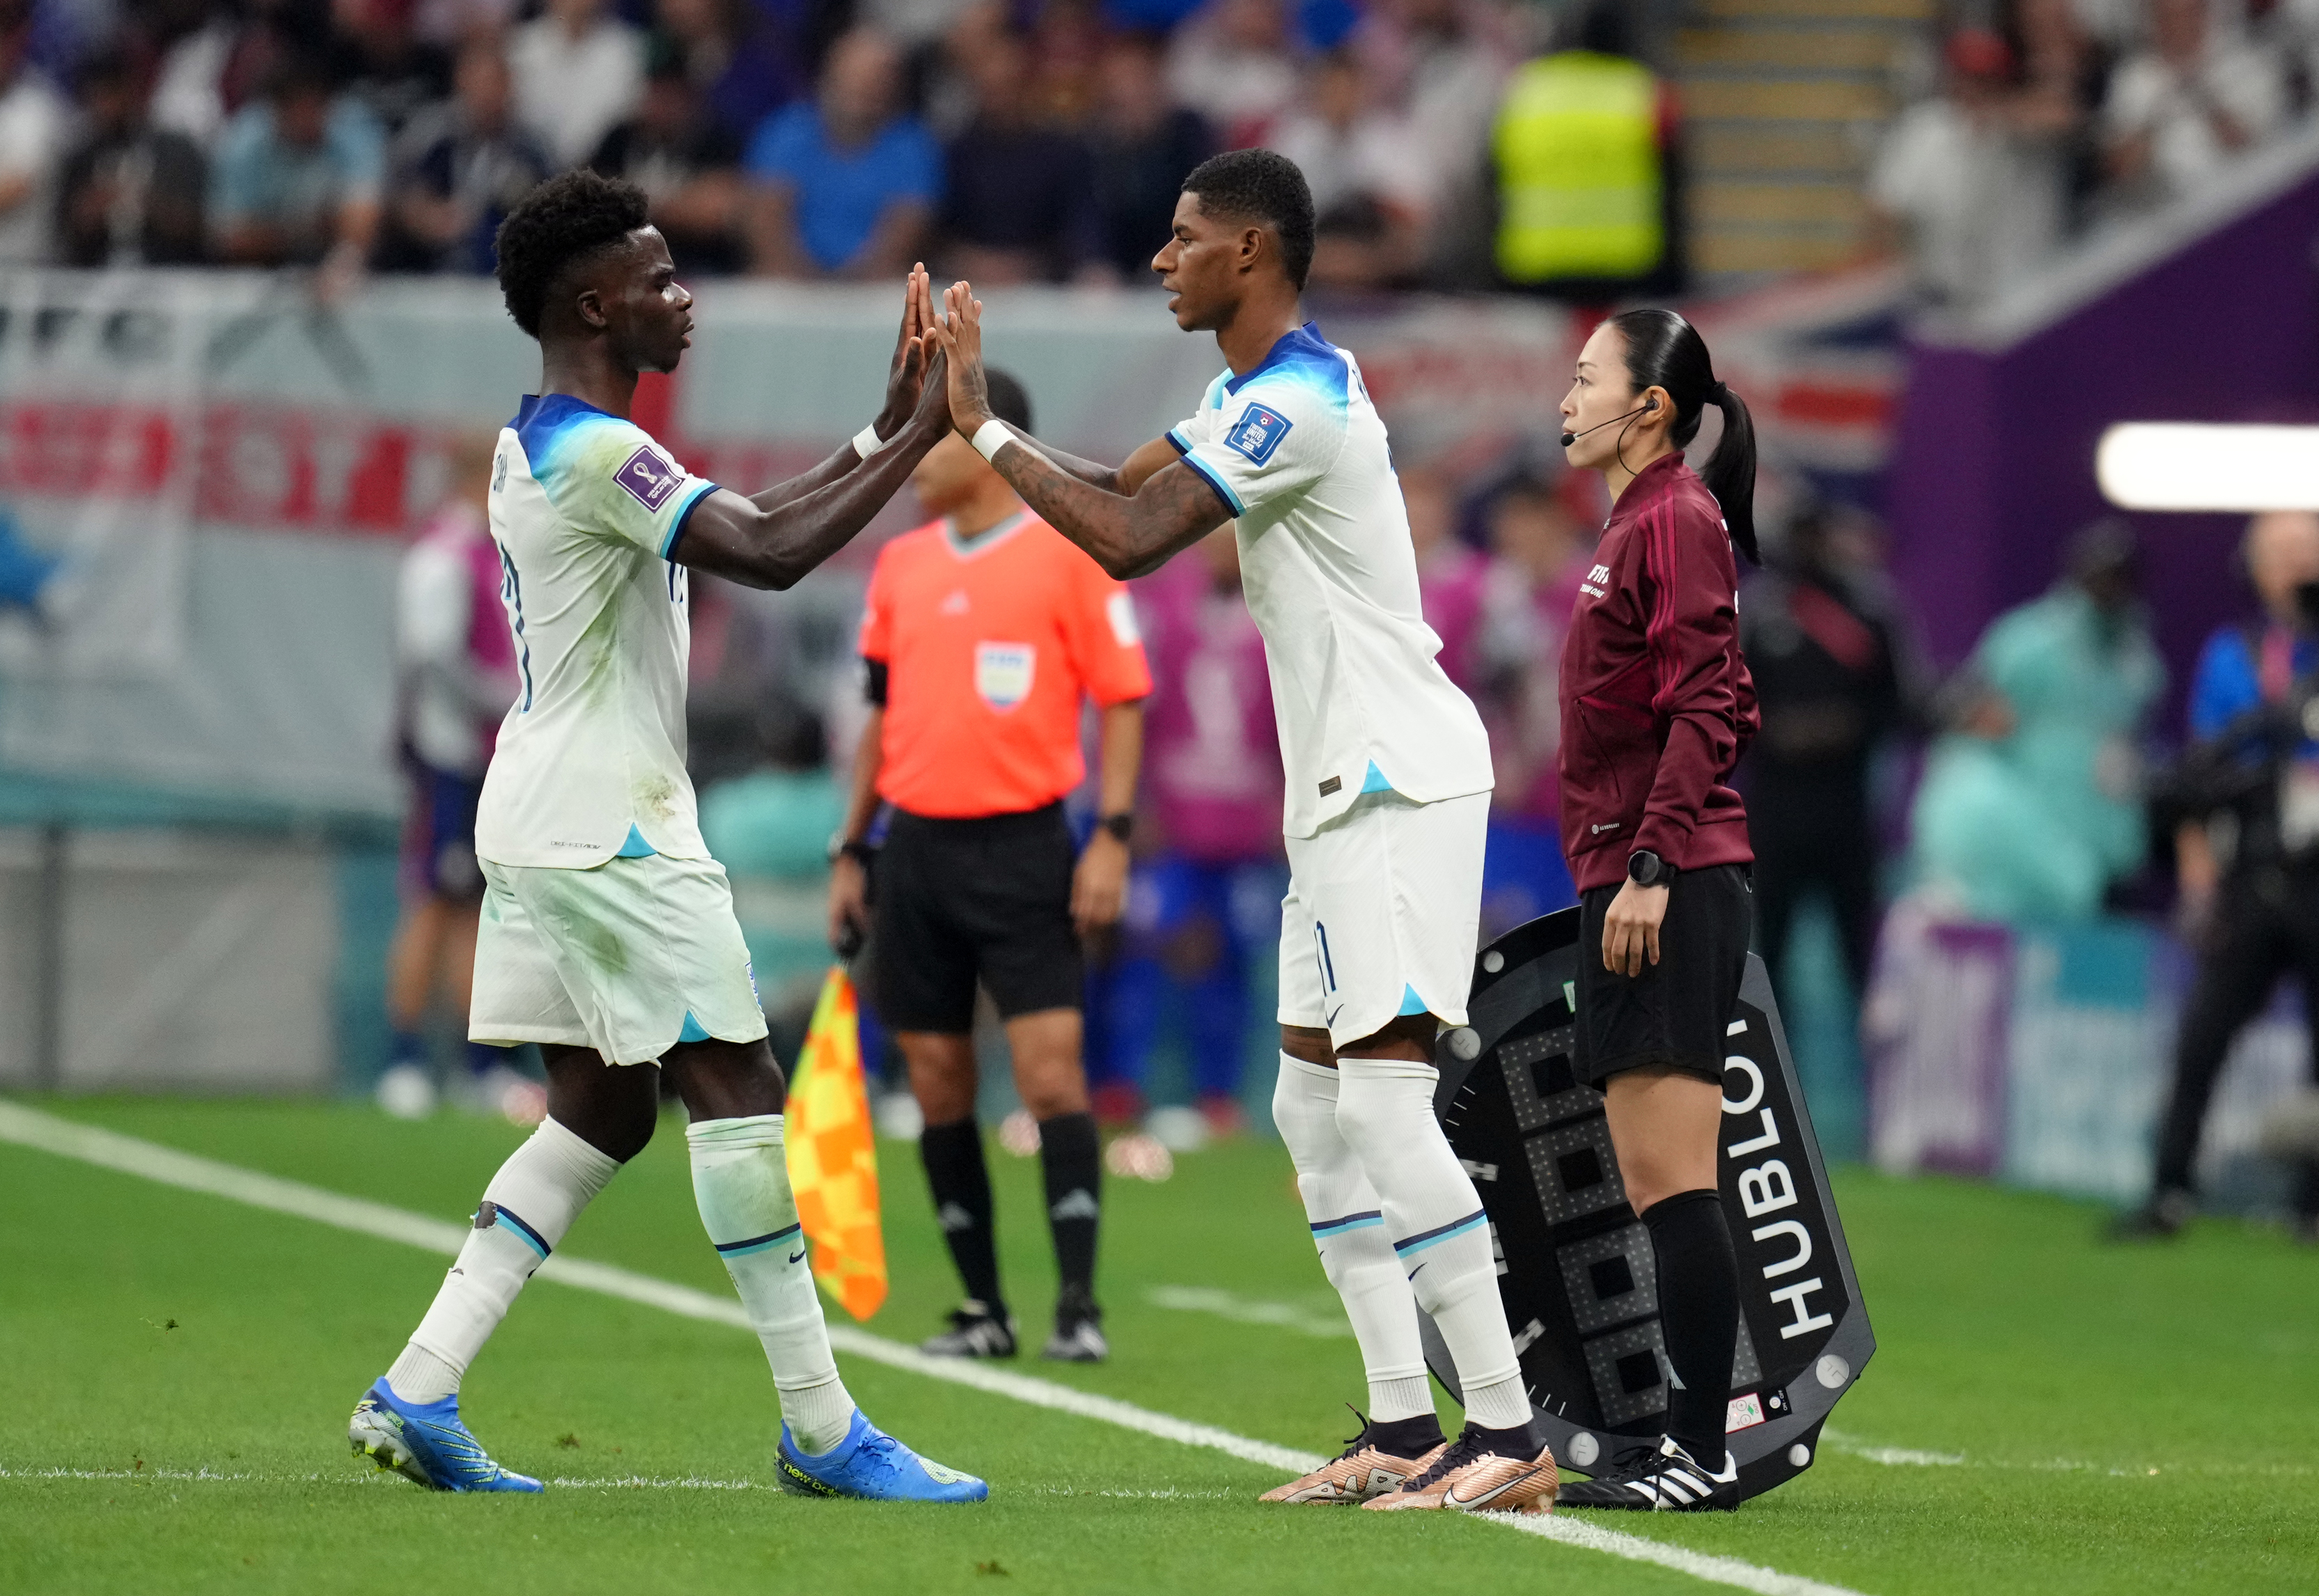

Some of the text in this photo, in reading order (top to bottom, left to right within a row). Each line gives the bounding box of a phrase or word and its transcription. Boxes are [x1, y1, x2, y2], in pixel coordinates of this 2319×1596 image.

[1247, 427, 1265, 442] UNITES
[1587, 564, 1609, 584] FIFA
[1590, 588, 1604, 598] ONE
[1721, 1019, 1833, 1340] HUBLO
[784, 1463, 811, 1483] new
